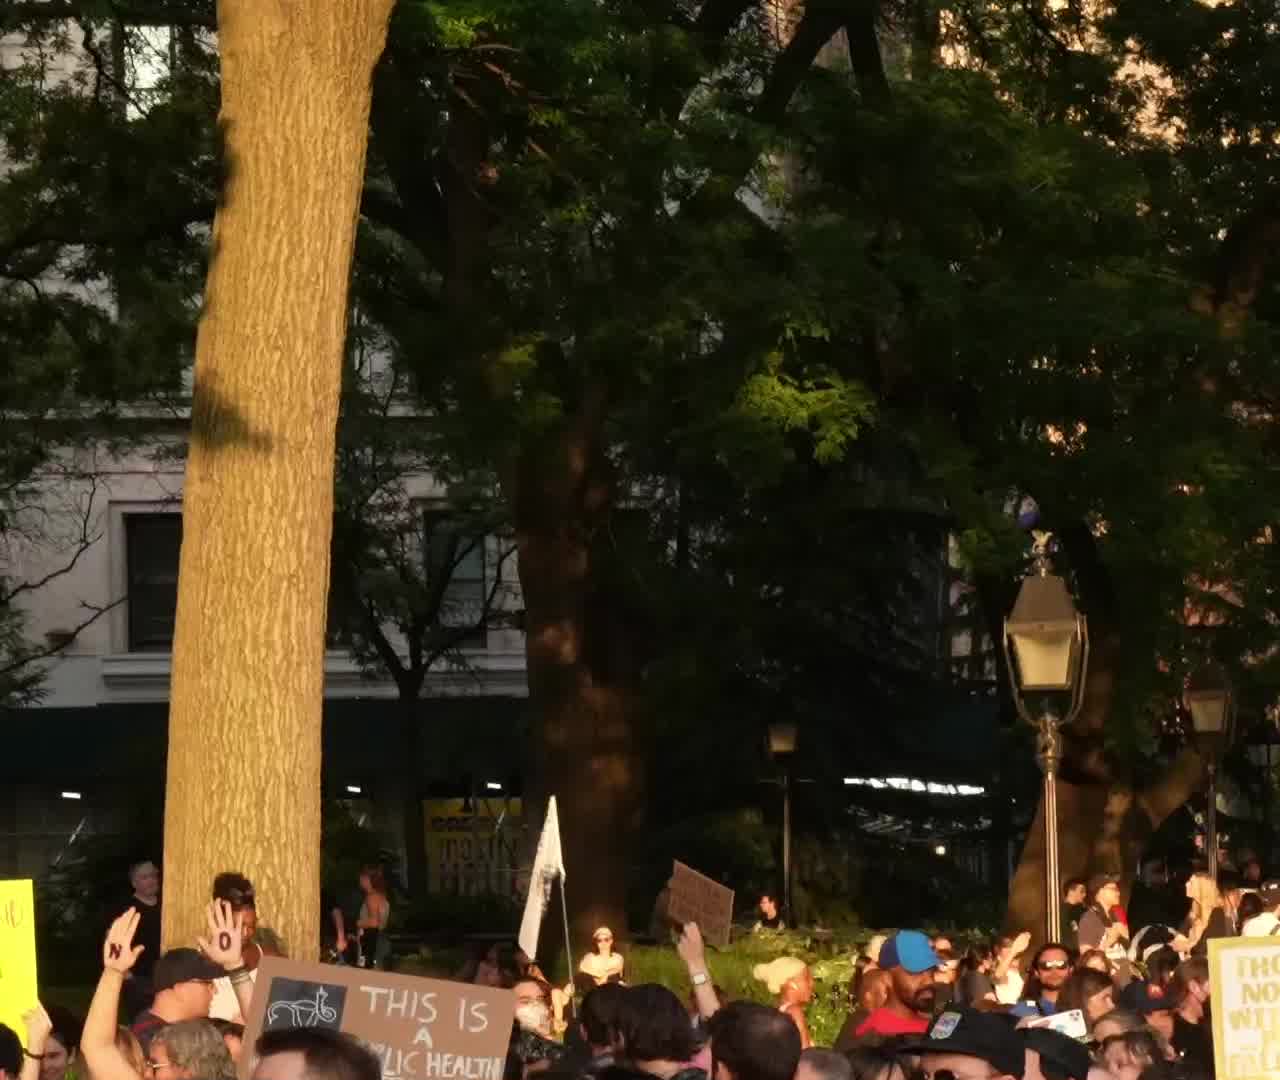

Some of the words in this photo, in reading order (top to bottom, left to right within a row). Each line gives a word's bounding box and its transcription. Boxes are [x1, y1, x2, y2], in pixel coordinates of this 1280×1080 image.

[359, 985, 438, 1024] THIS
[458, 998, 489, 1033] IS
[413, 1026, 432, 1048] A
[426, 1051, 502, 1080] HEALTH
